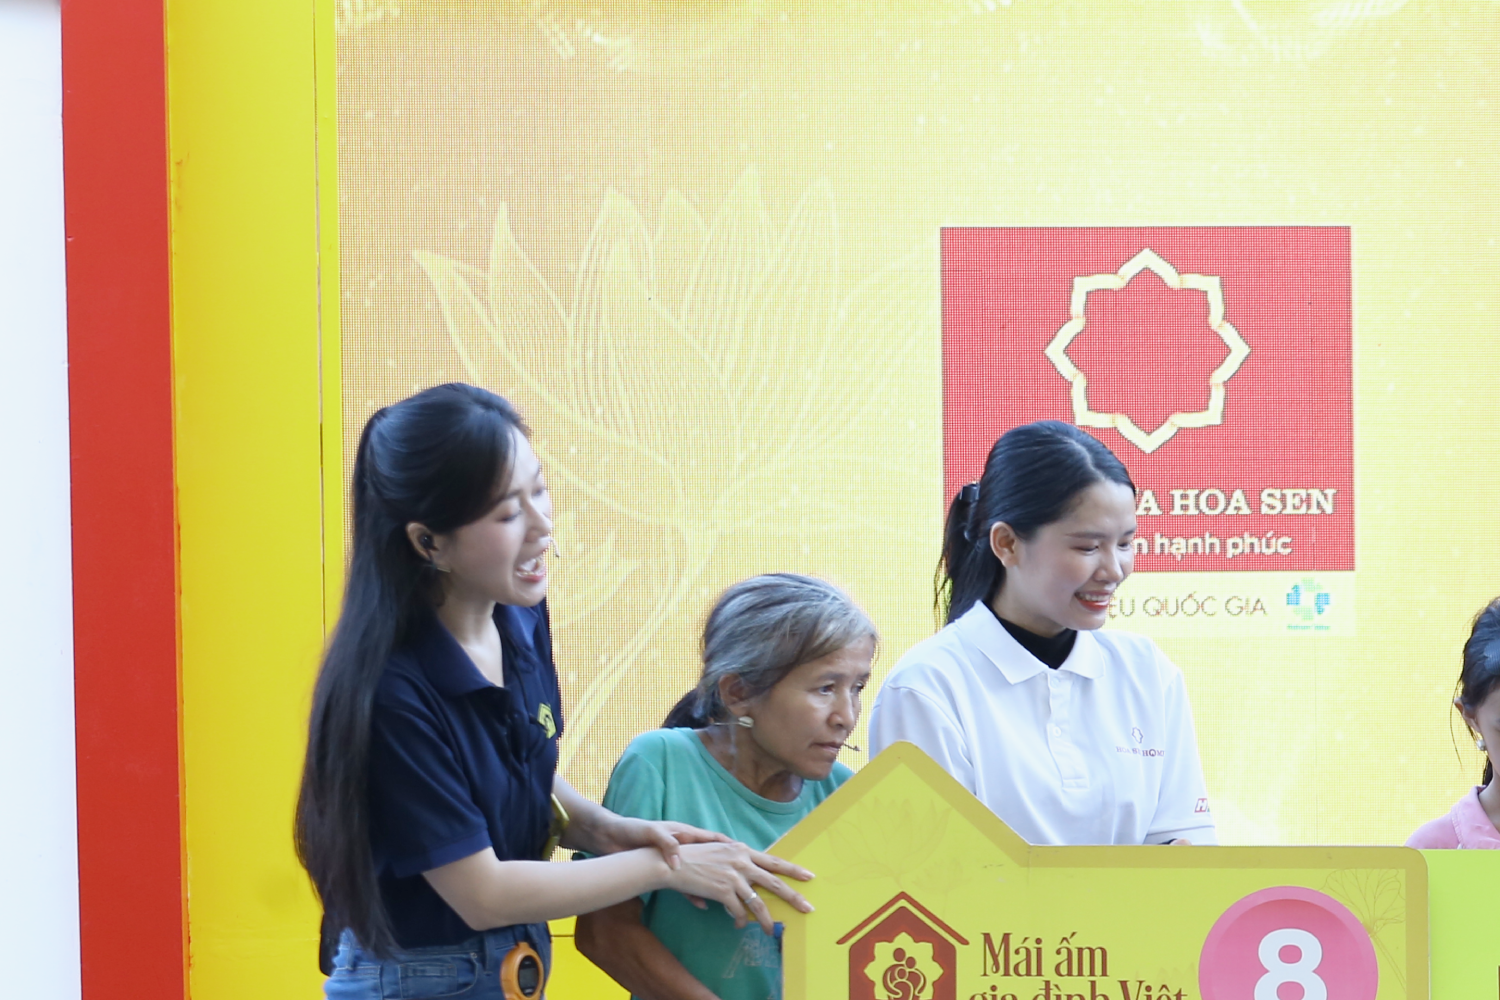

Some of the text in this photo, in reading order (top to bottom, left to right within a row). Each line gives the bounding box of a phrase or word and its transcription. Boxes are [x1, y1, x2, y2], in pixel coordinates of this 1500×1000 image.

[1169, 488, 1253, 516] HOA
[1259, 488, 1338, 516] SEN
[1153, 531, 1221, 562] hạnh
[1226, 530, 1293, 559] phúc
[1224, 595, 1267, 617] GIA
[980, 931, 1110, 978] Mái ấm
